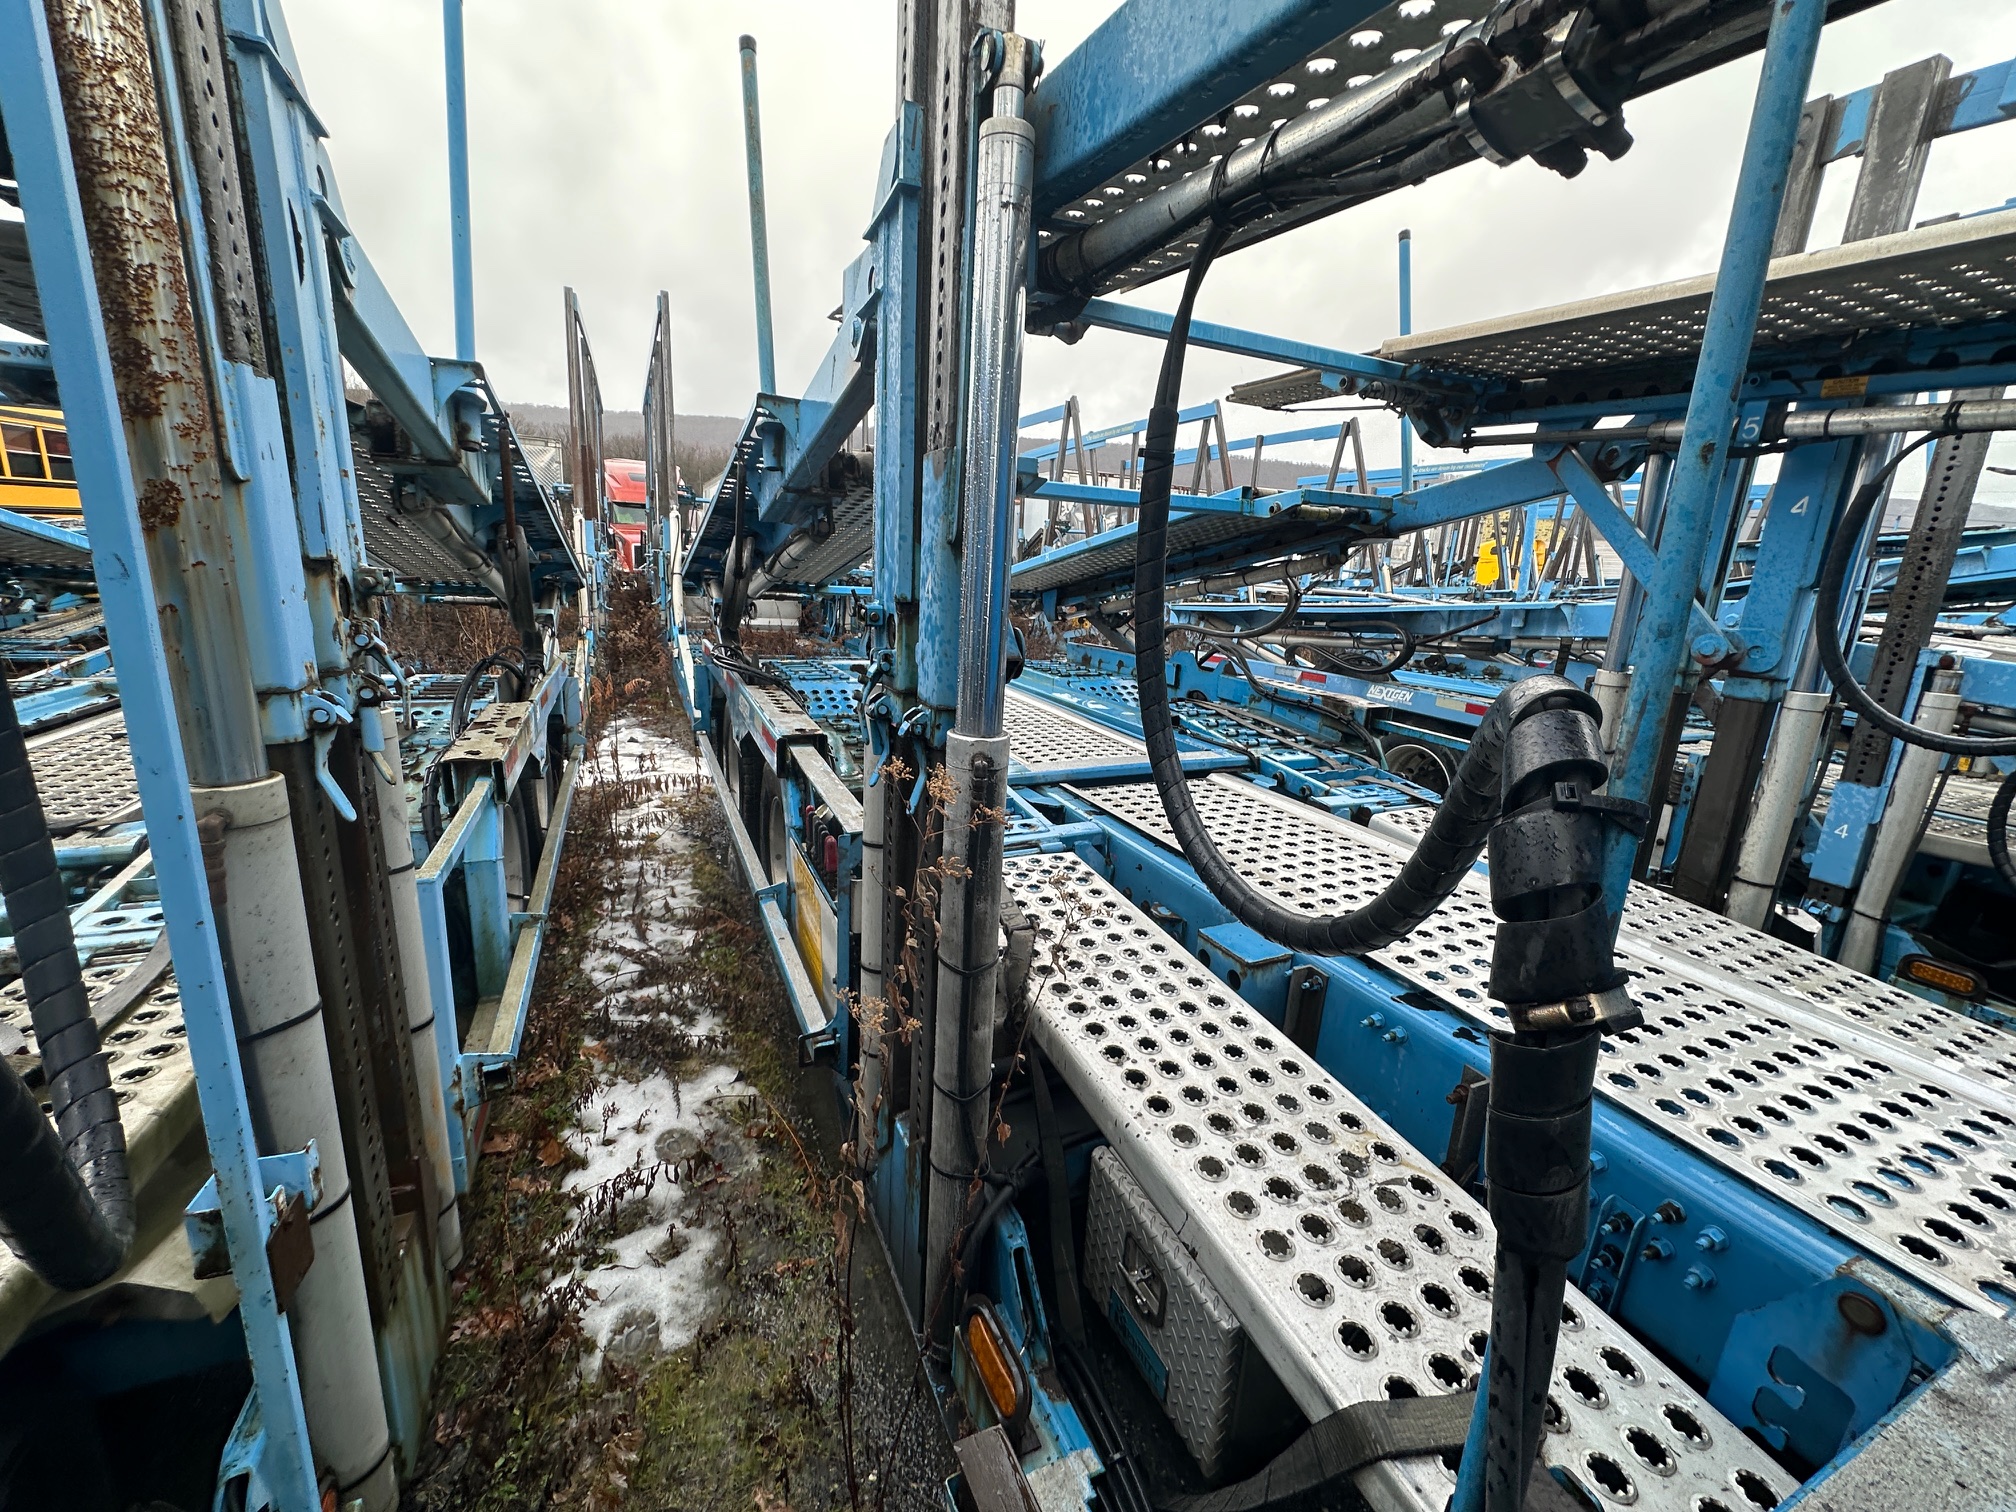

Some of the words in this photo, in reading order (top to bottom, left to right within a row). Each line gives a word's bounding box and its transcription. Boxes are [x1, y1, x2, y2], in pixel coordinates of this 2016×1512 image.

[1741, 416, 1760, 440] 5
[1790, 495, 1810, 517] 4
[1366, 684, 1414, 704] NEXTGEN
[1833, 824, 1848, 839] 4
